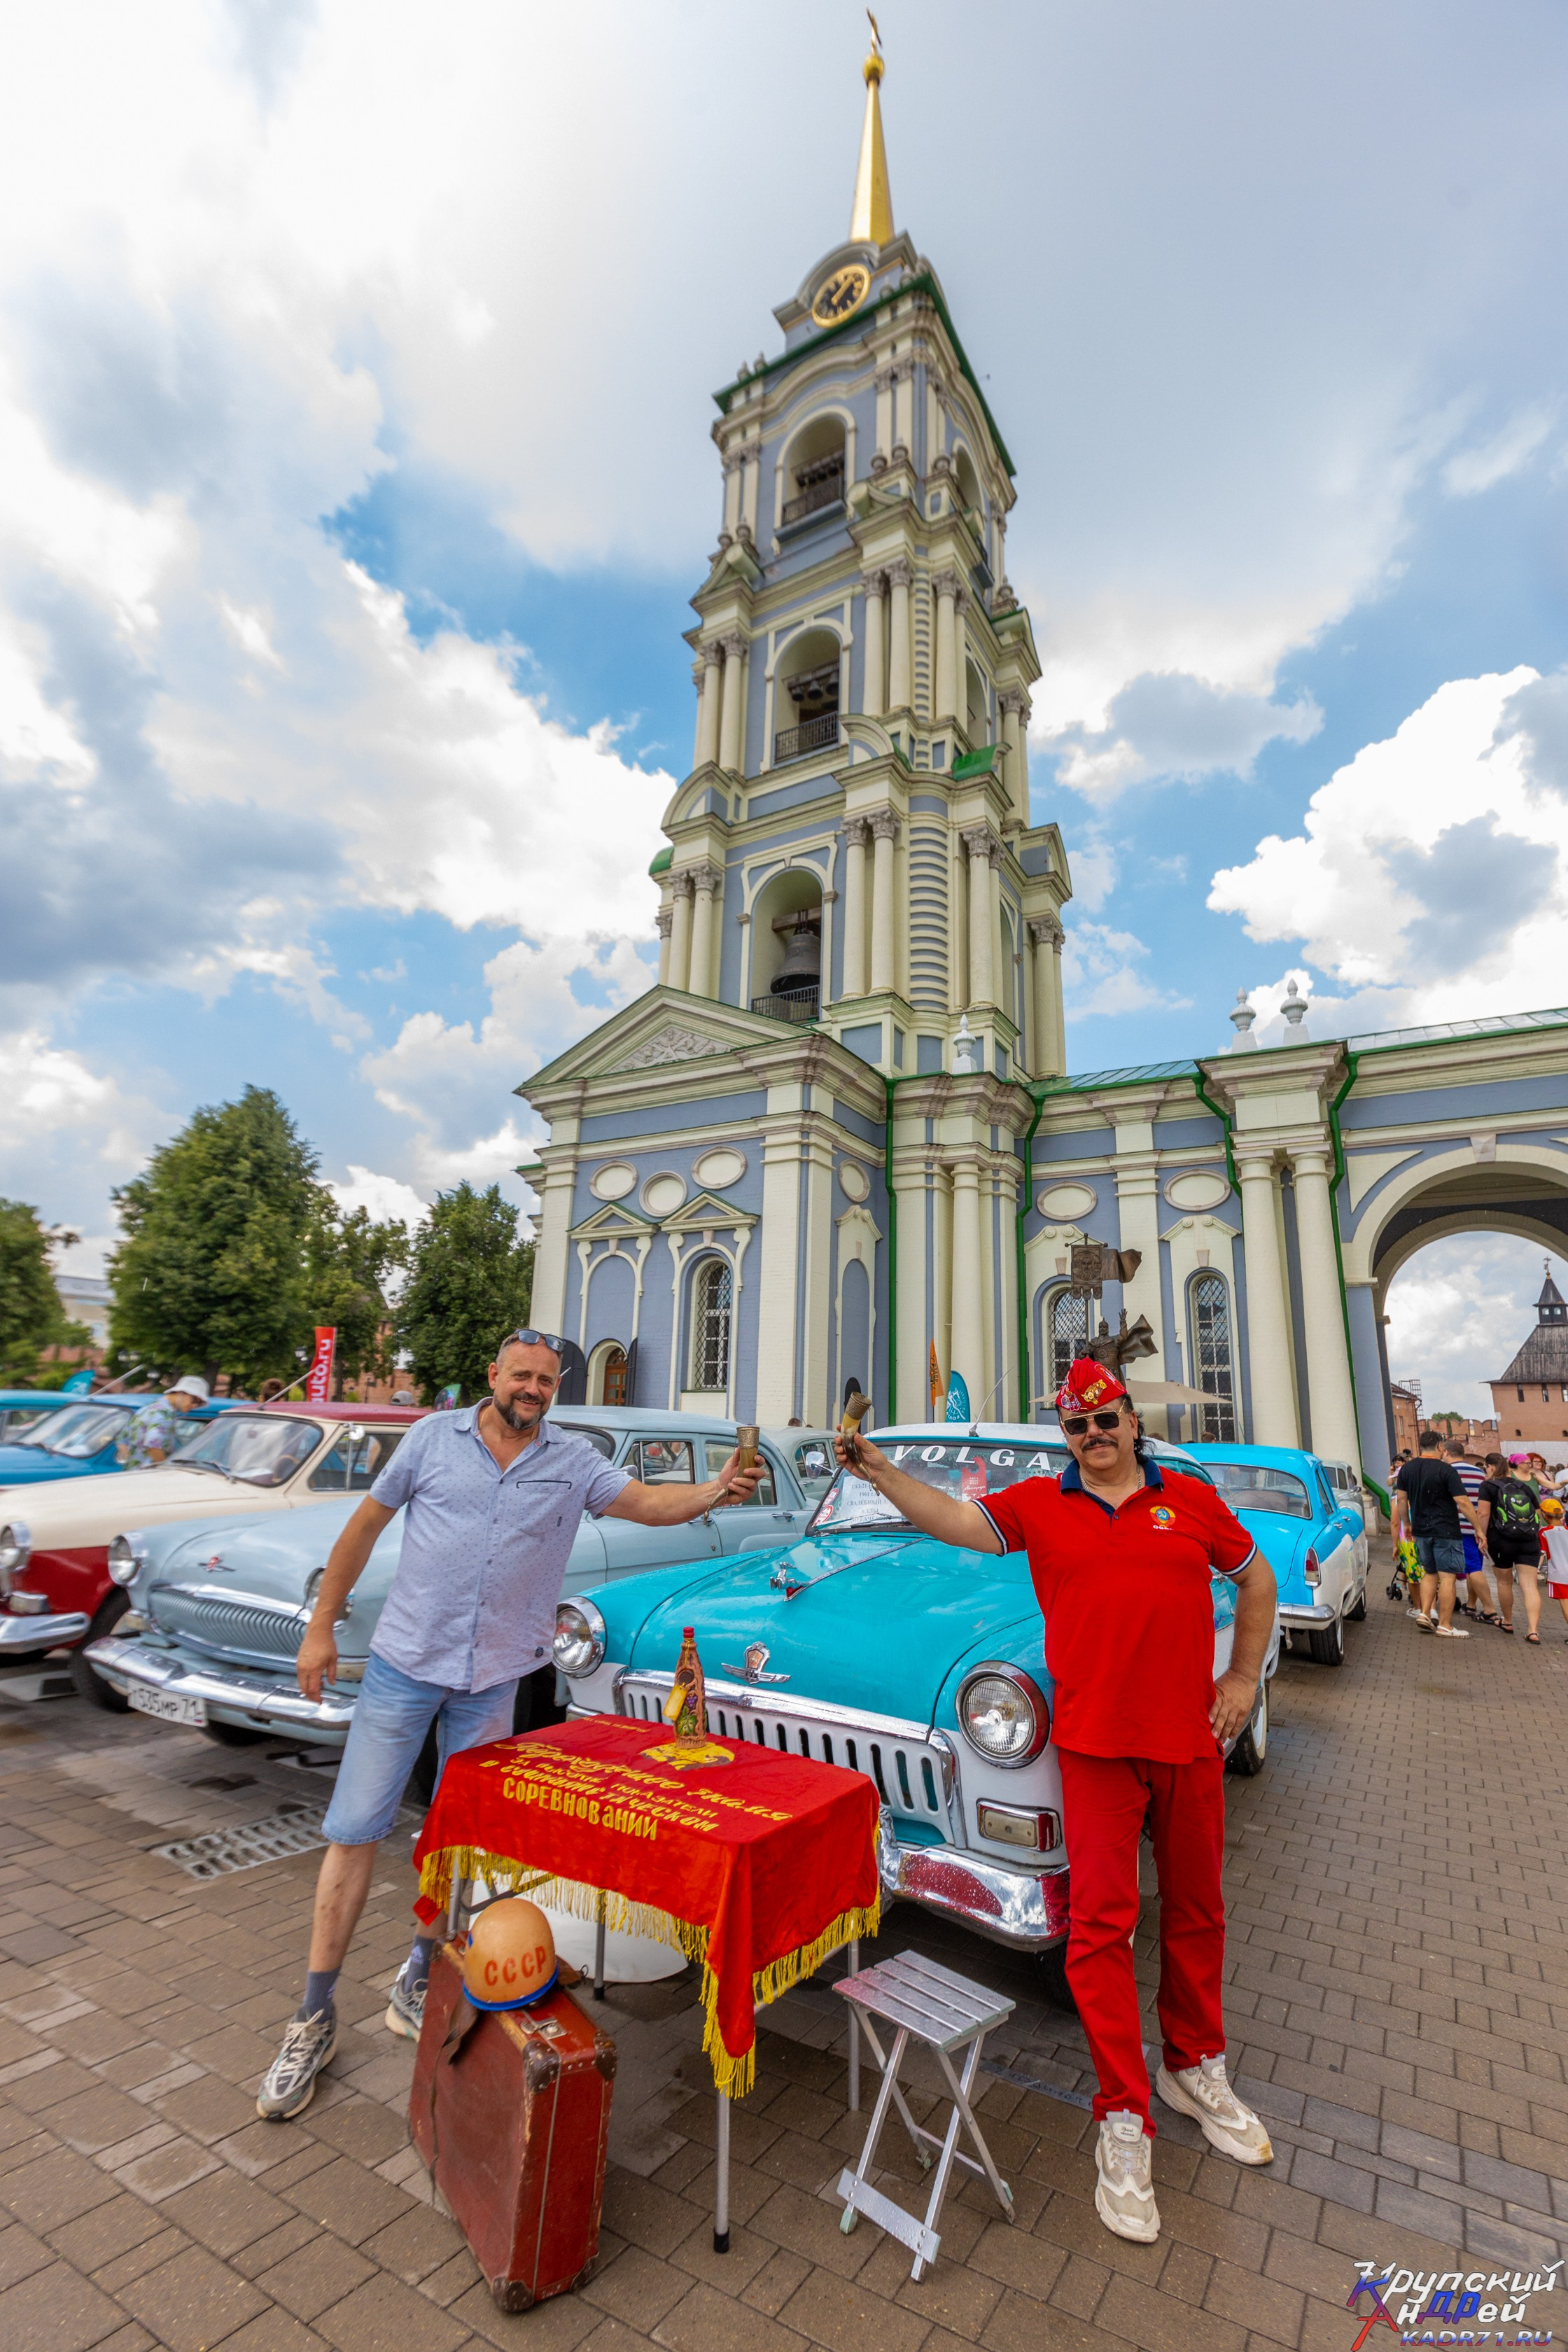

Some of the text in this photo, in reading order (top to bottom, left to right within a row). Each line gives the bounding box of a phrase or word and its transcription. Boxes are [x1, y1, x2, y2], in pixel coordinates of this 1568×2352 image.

[894, 1445, 1051, 1471] VOLGA
[611, 1784, 718, 1818] ПОКАЗАТЕЛИ
[484, 1945, 546, 1987] СССР
